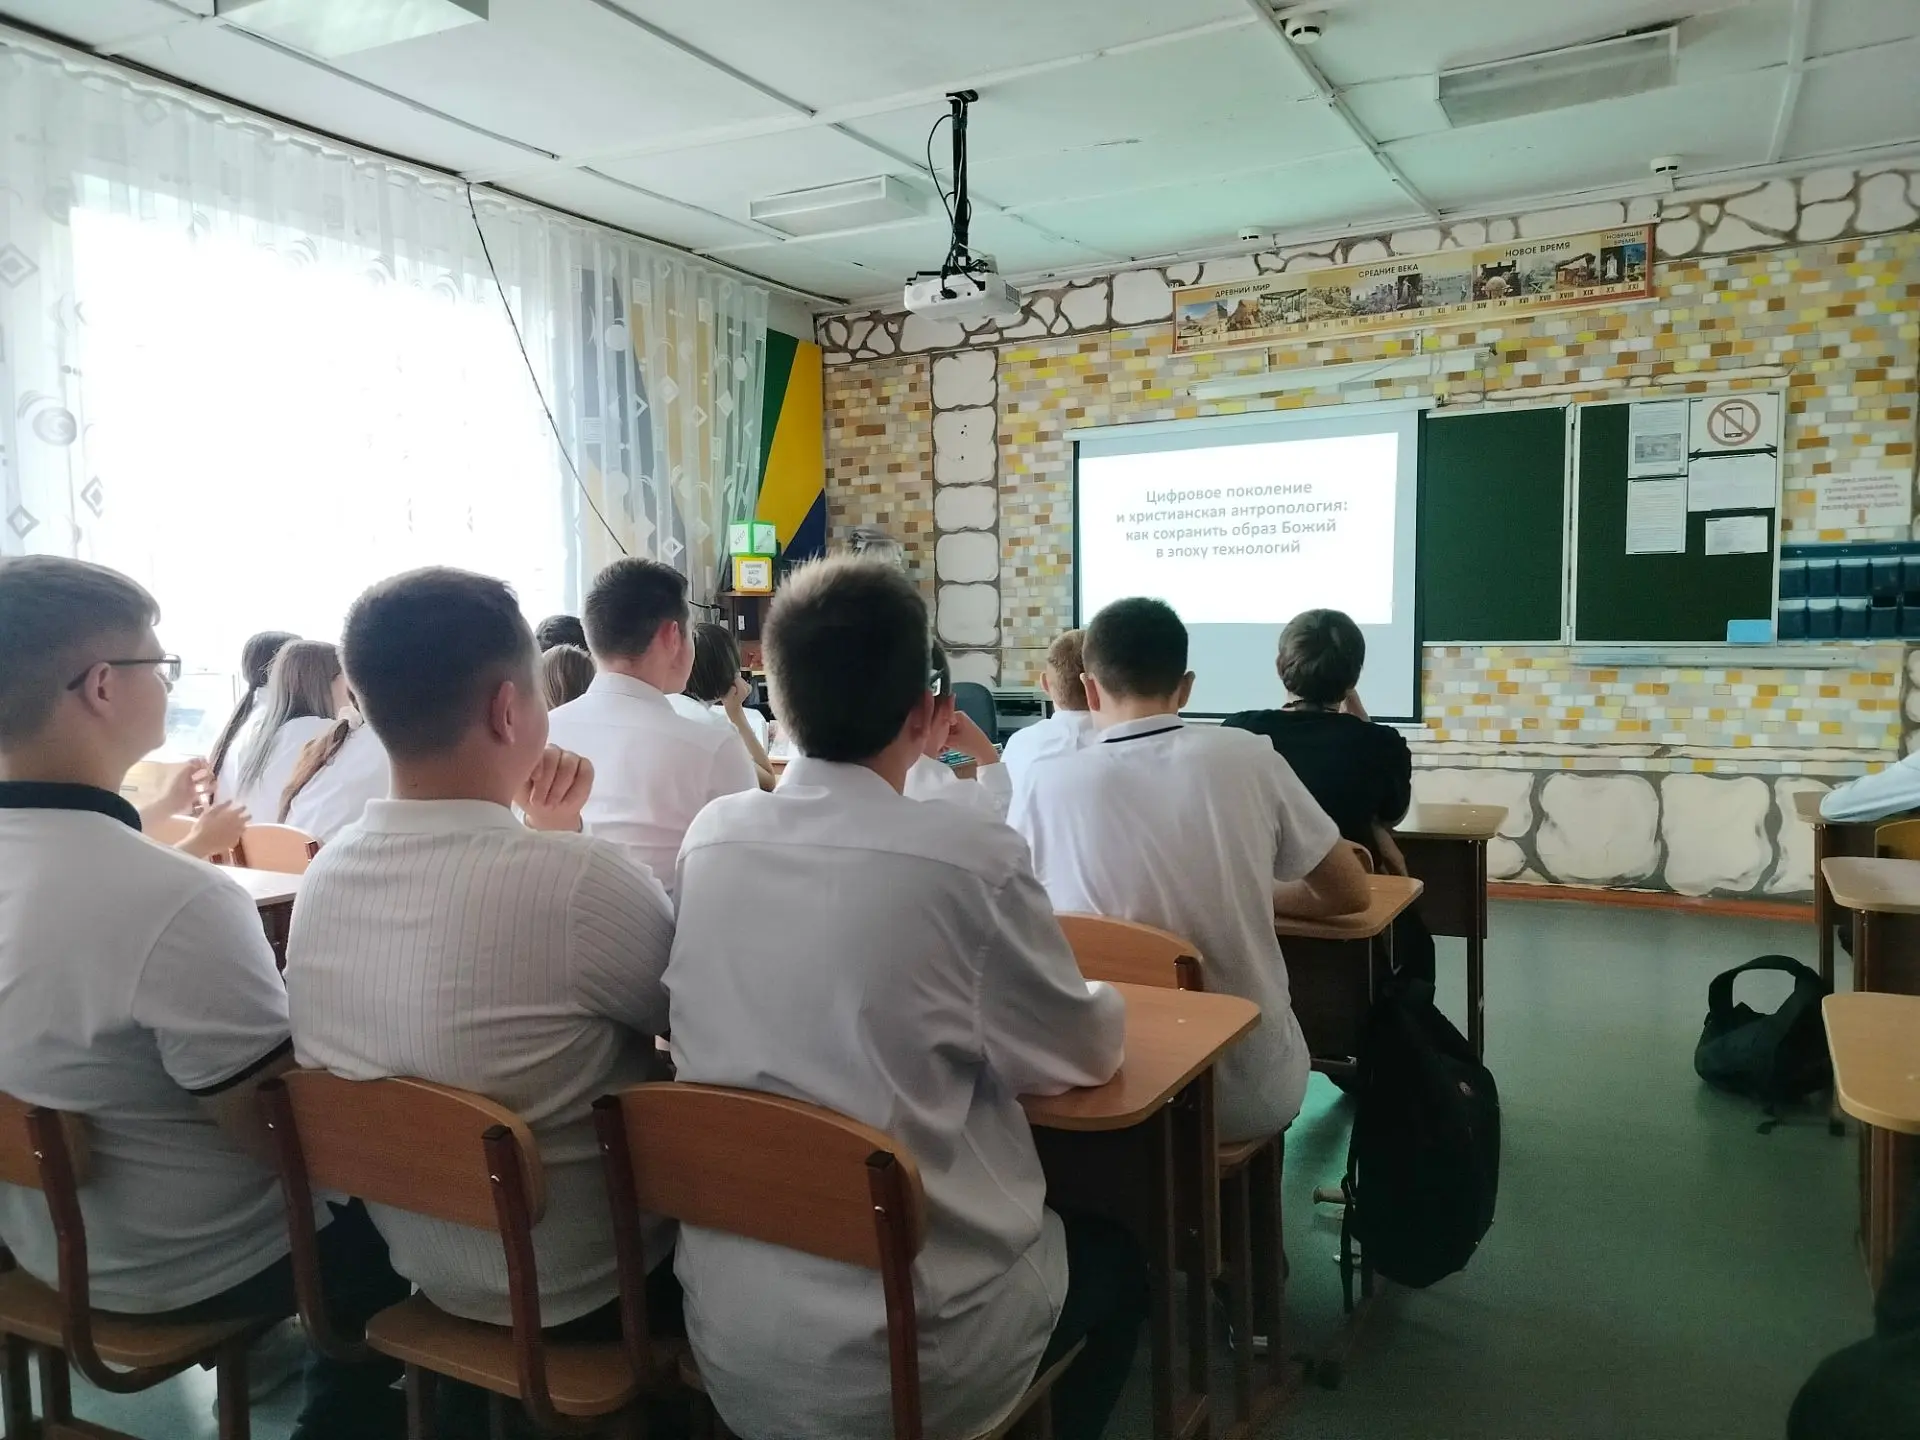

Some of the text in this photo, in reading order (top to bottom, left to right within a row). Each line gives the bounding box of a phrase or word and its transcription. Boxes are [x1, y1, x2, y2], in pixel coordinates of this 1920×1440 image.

[1505, 241, 1571, 258] НОВОЕ ВРЕМЯ
[1358, 262, 1419, 279] СРЕДНИЕ ВЕКА
[1214, 282, 1271, 299] ДРЕВНИЙ МИР
[1456, 304, 1467, 312] XIII
[1476, 301, 1487, 309] XIV
[1559, 291, 1575, 300] XVIII
[1583, 288, 1595, 296] XIX
[1627, 282, 1640, 291] XXI
[1146, 483, 1312, 505] Цифровое поколение
[1116, 501, 1348, 524] и христианская антропология:
[1126, 518, 1336, 541] как сохранить образ Божий
[1156, 539, 1301, 559] в эпоху технологий
